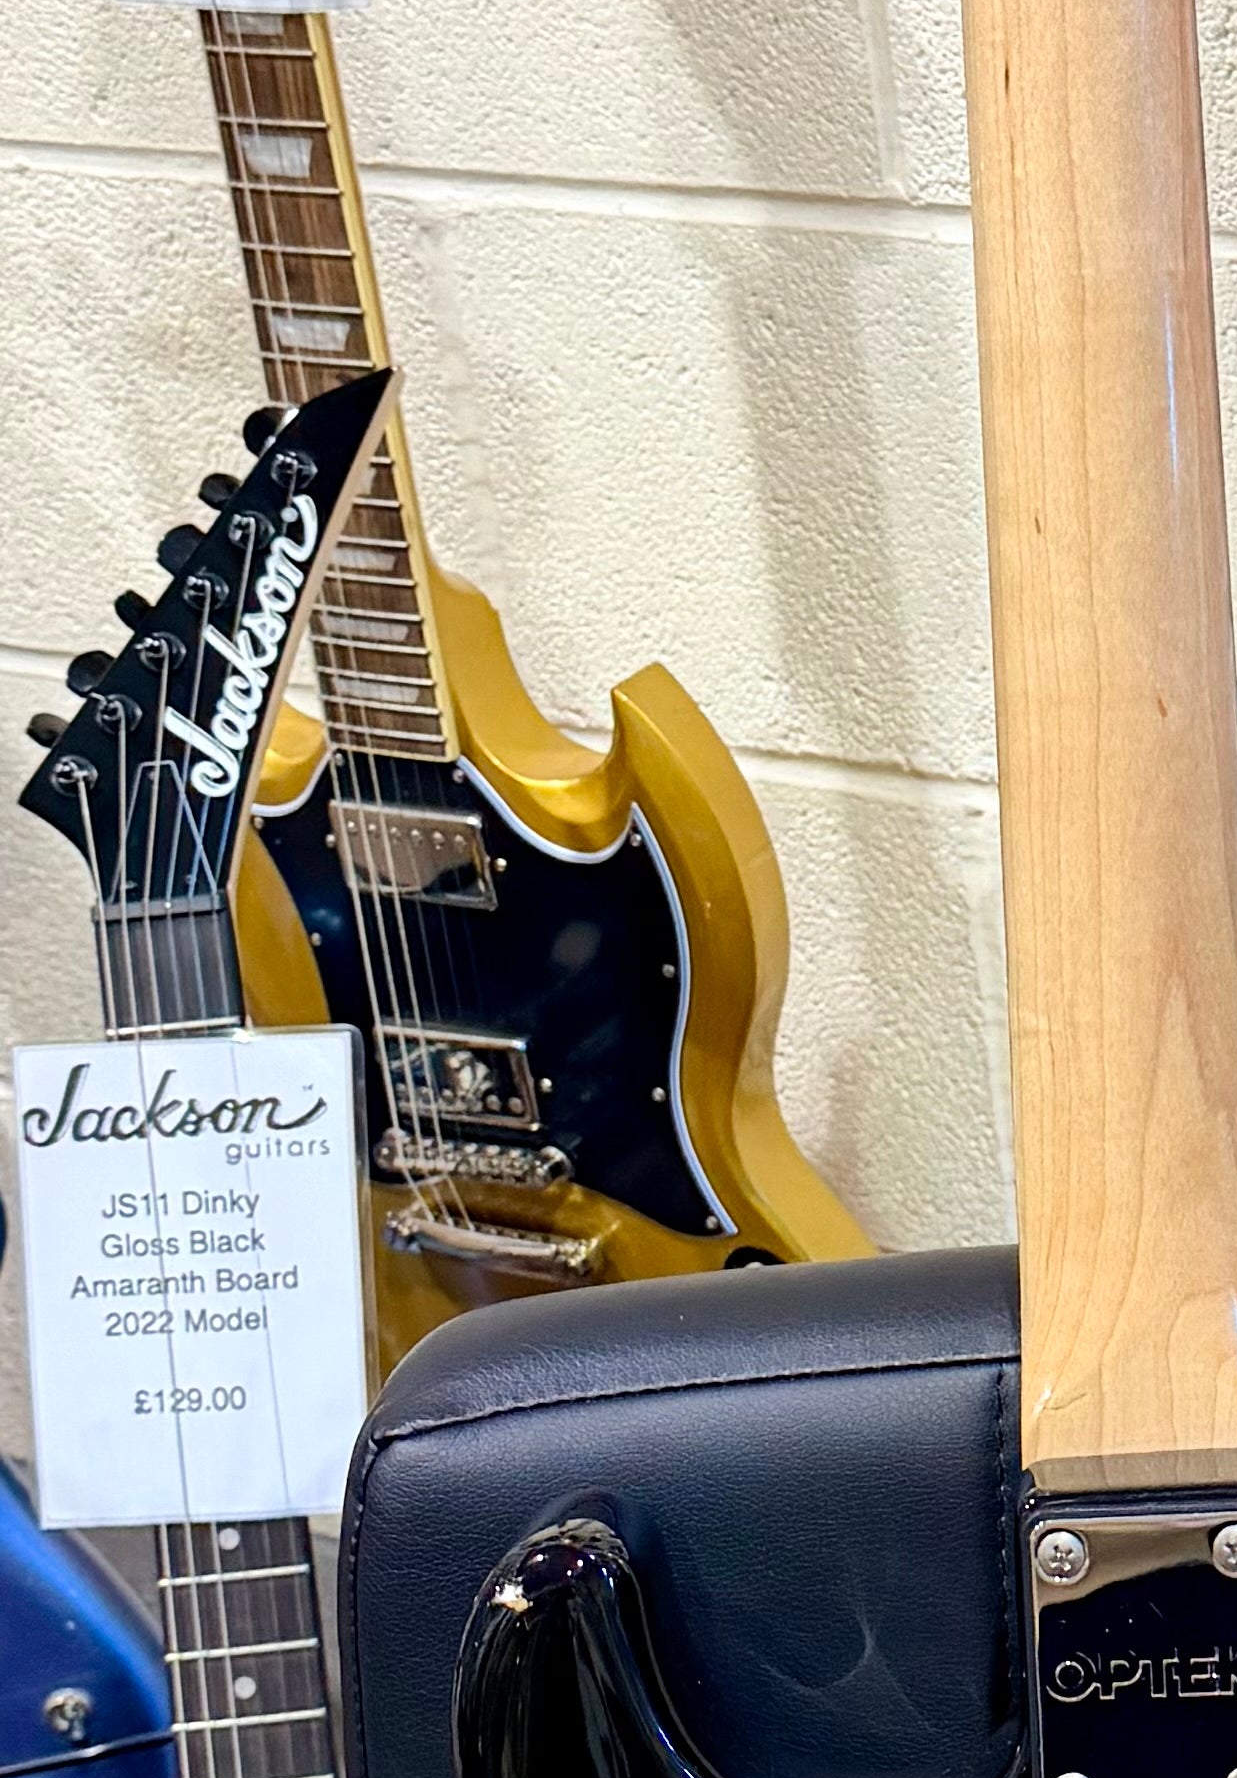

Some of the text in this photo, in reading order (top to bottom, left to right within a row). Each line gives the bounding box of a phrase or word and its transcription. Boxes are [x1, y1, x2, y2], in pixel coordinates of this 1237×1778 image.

[164, 493, 319, 799] Jackson
[23, 1062, 328, 1147] Jackson
[224, 1137, 330, 1164] guitars
[102, 1189, 260, 1219] JS11 Dinky
[100, 1228, 266, 1258] Gloss Black
[71, 1265, 299, 1301] Amaranth Board
[105, 1306, 268, 1337] 2022 Model
[134, 1385, 247, 1415] £129.00
